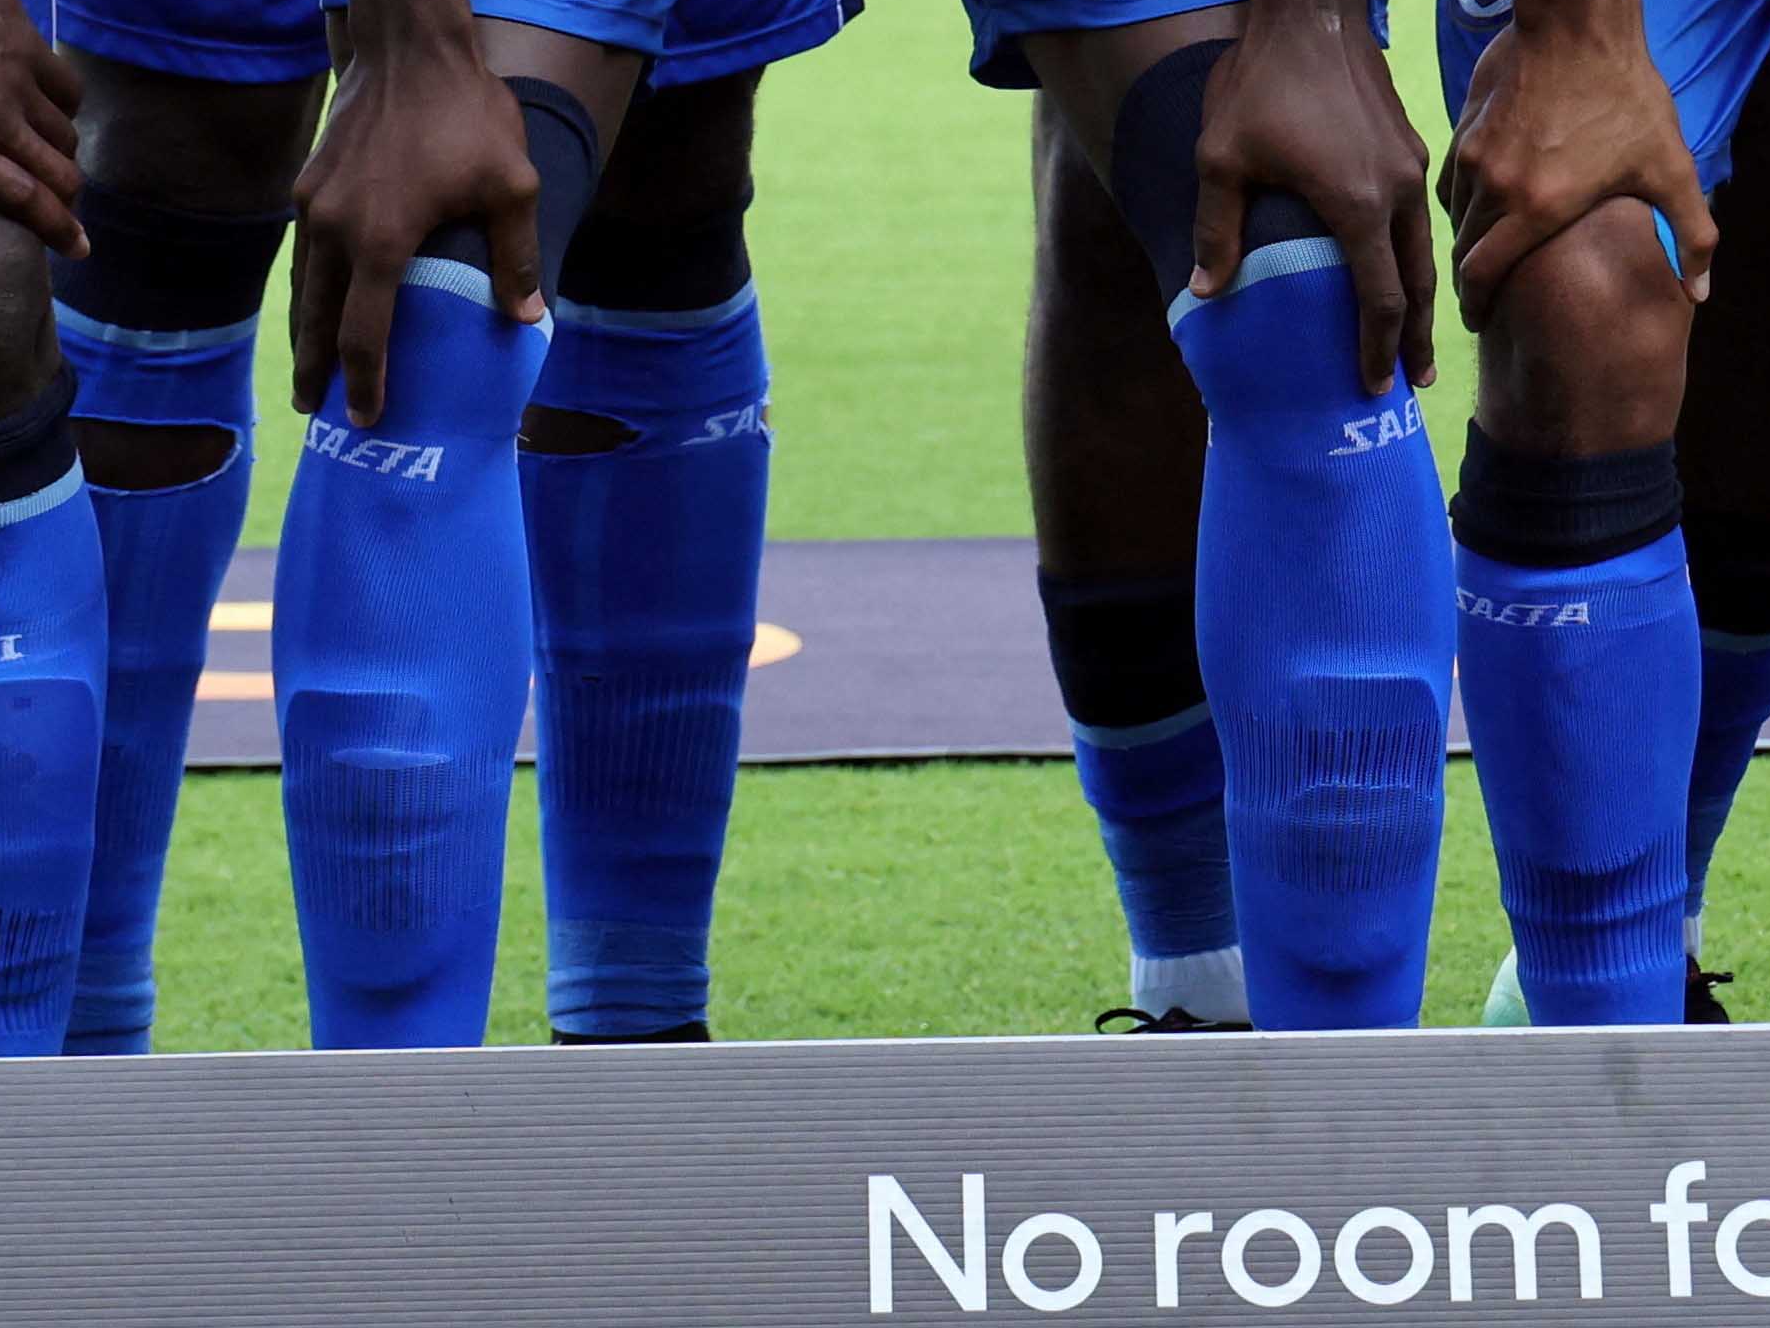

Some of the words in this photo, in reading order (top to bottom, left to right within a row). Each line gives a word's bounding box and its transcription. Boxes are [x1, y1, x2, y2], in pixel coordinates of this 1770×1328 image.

[307, 418, 443, 482] SAETA
[1329, 398, 1422, 456] SAE
[868, 1174, 1104, 1314] No
[1155, 1205, 1605, 1309] room
